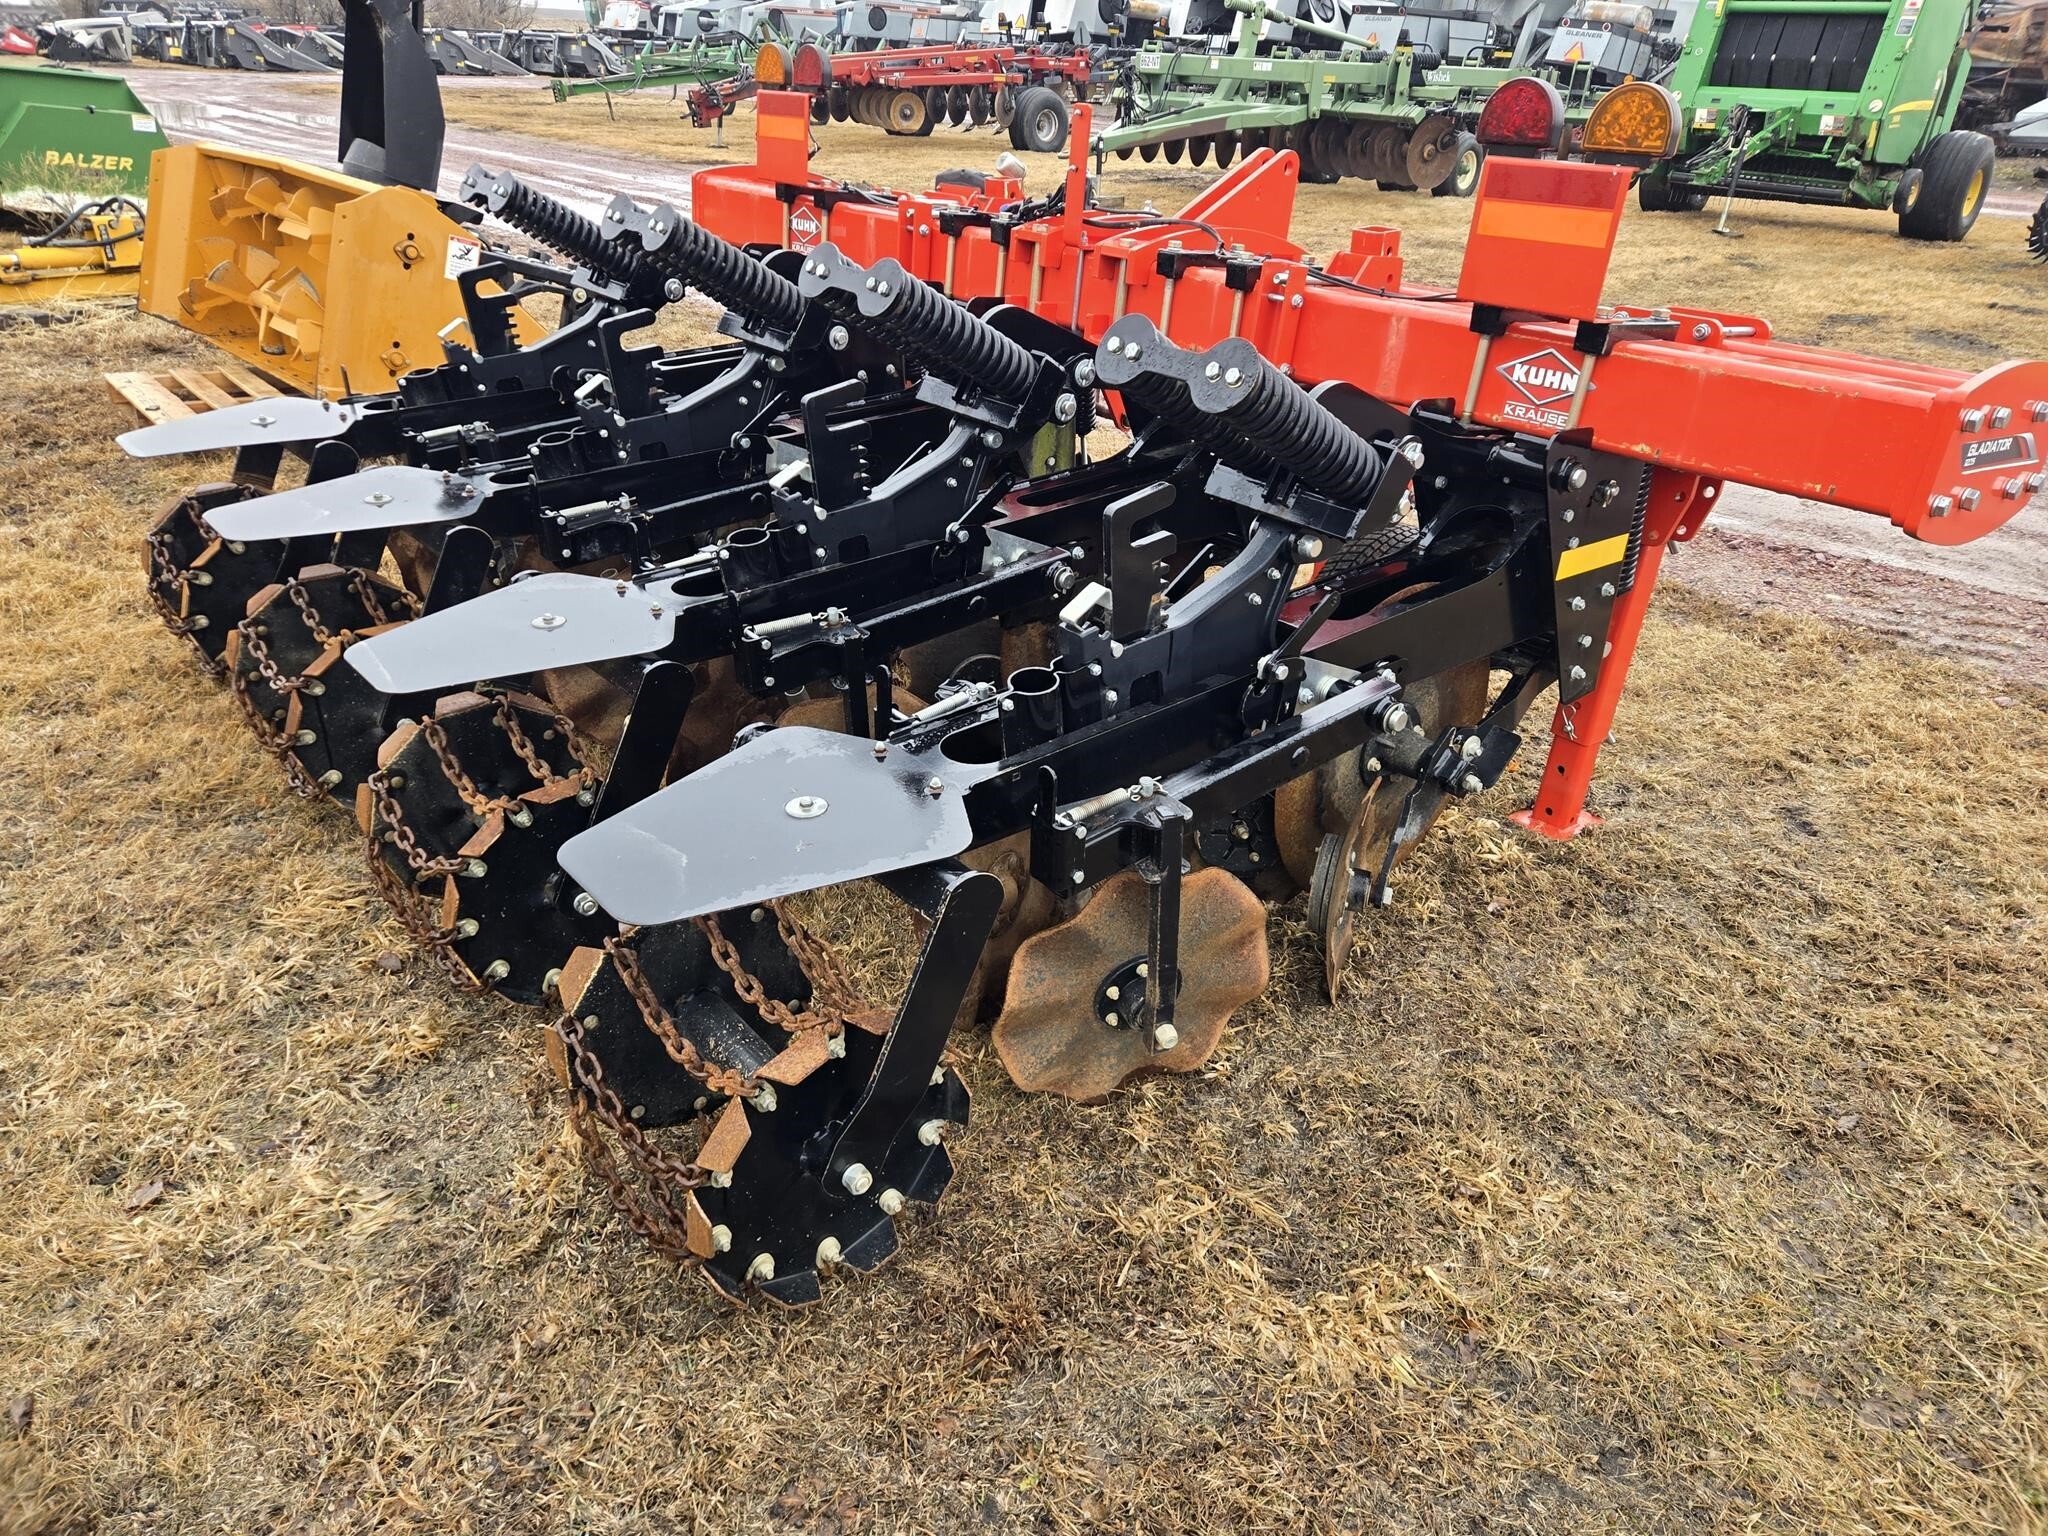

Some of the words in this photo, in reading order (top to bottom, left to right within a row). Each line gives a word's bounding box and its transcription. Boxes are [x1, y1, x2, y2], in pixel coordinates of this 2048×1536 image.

[1565, 29, 1603, 39] GLEANER
[45, 150, 134, 172] BALZER
[792, 217, 816, 233] KUHN
[1512, 363, 1579, 392] KUHN
[1503, 404, 1569, 427] KRAUSE
[1967, 437, 2014, 457] GLADIATOR
